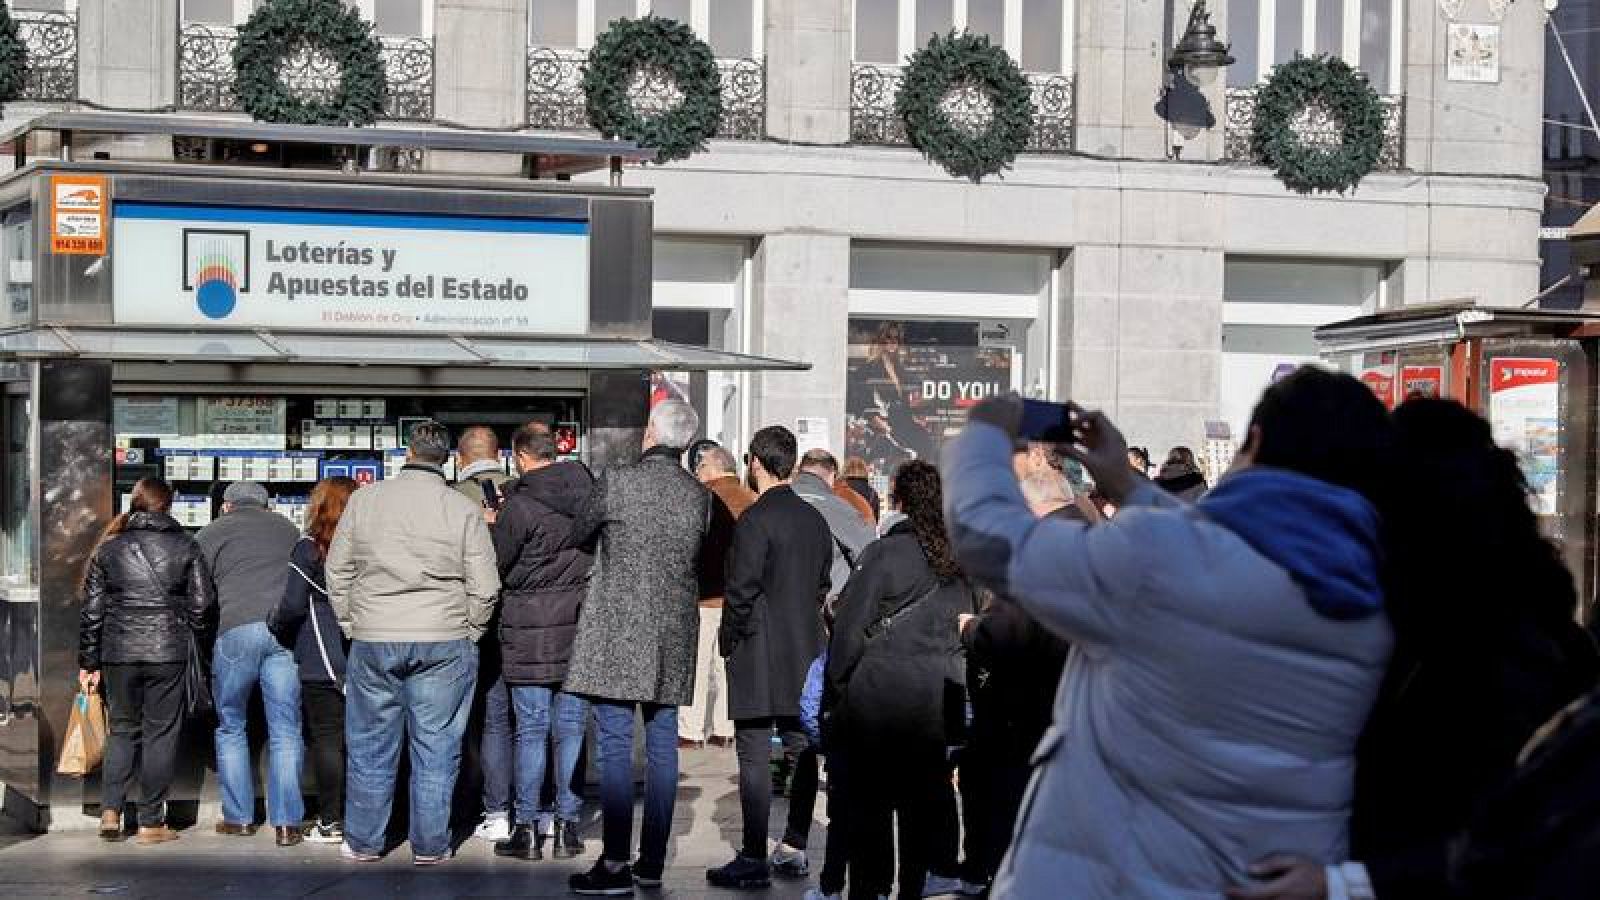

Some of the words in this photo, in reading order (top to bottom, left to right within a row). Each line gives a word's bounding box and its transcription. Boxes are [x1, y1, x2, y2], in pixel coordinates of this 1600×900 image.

[266, 239, 374, 264] Loterías
[382, 248, 396, 272] y
[267, 271, 388, 300] Apuestas
[396, 274, 433, 298] del
[442, 277, 528, 301] Estado
[923, 381, 951, 399] DO
